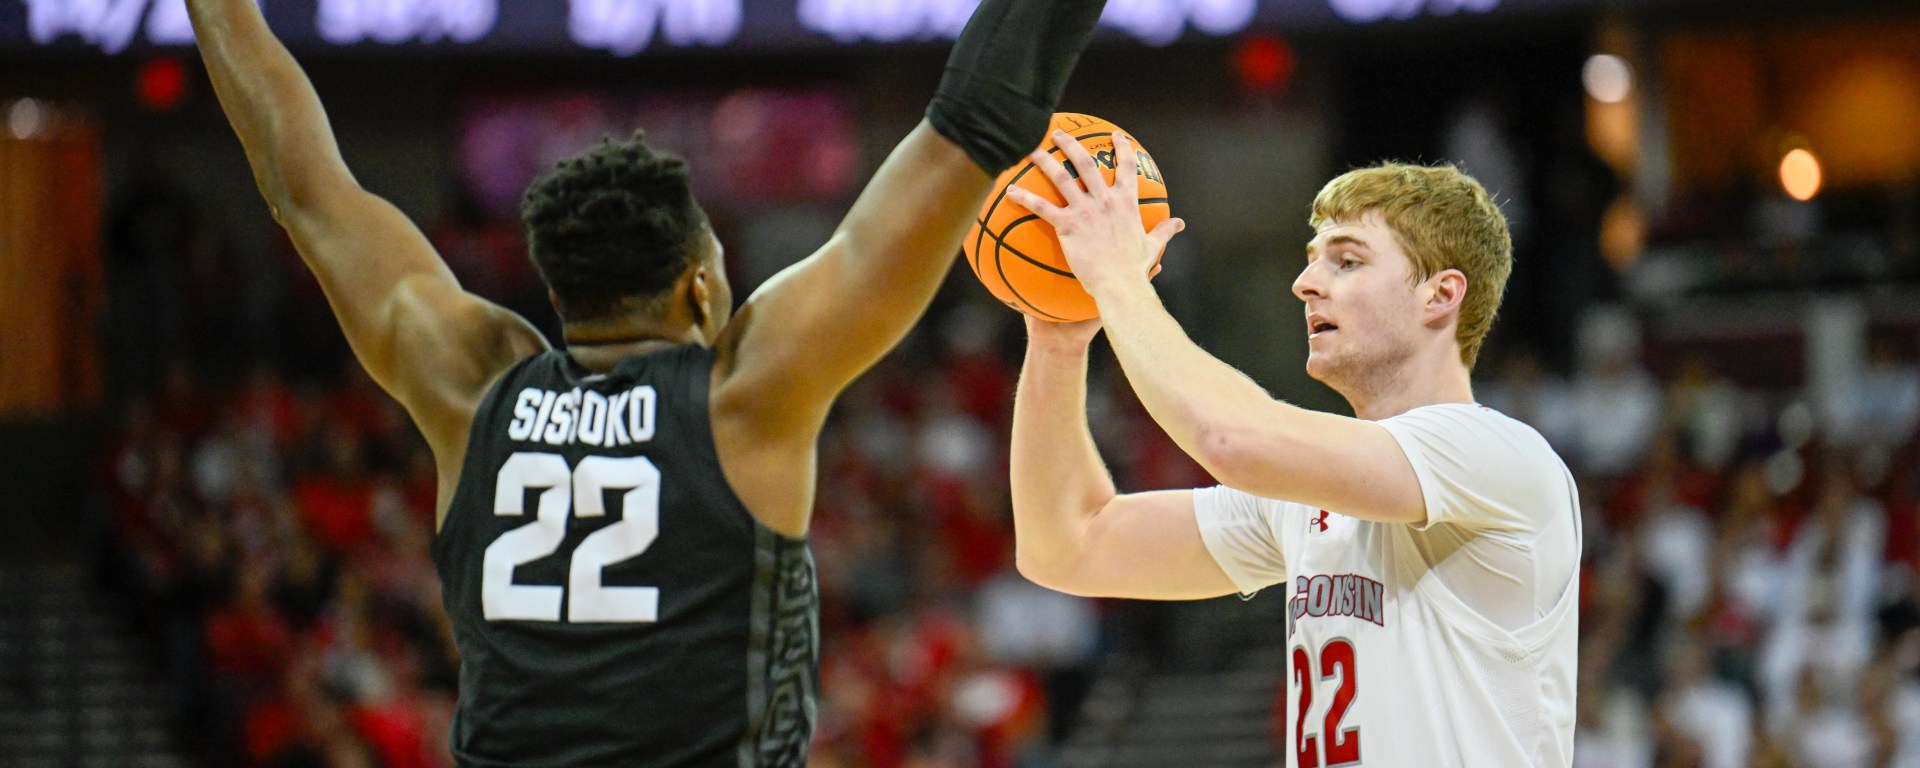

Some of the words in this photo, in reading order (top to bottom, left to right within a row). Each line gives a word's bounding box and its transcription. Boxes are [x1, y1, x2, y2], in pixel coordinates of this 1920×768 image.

[482, 452, 661, 622] 22
[1288, 573, 1384, 640] CONSIN
[1293, 636, 1362, 768] 22
